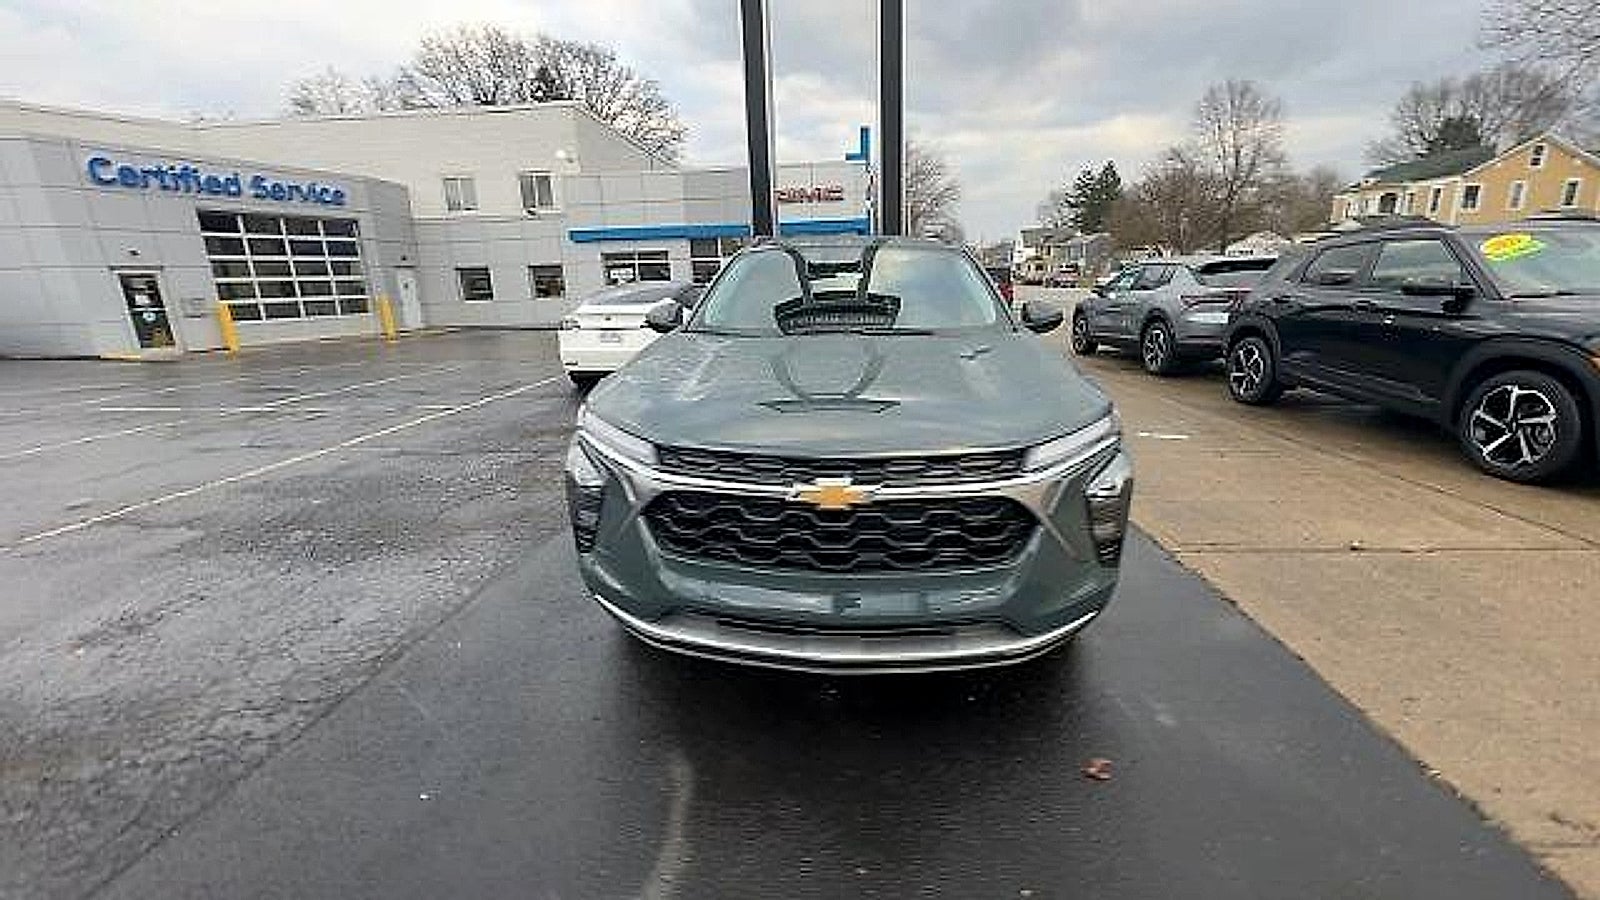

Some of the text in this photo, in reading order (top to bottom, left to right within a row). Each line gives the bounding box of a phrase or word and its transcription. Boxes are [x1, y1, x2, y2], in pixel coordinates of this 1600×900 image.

[87, 157, 346, 206] Certified Service
[775, 185, 844, 203] GMC
